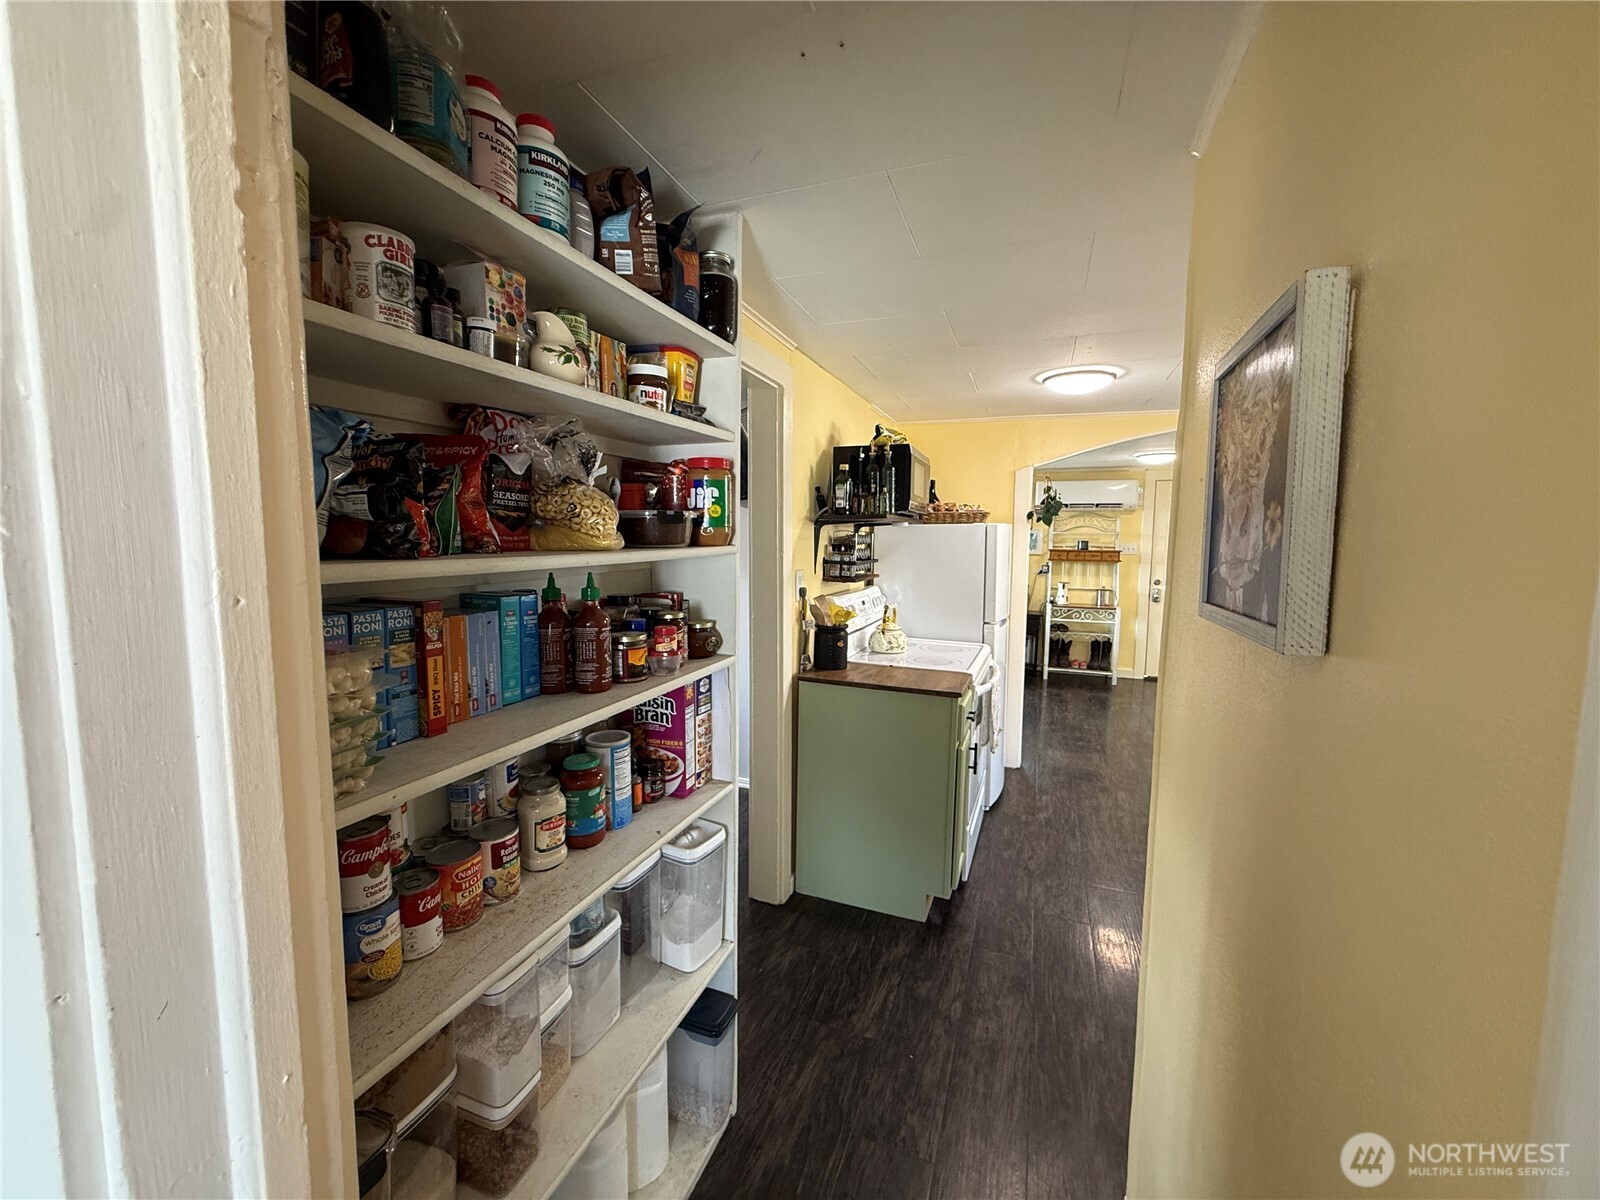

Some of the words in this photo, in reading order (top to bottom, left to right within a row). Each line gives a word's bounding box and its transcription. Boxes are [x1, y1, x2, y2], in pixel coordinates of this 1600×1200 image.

[478, 131, 512, 152] CALCIUM
[519, 167, 560, 184] MAGNESIUM
[543, 180, 555, 190] 250
[383, 248, 412, 269] GIRL
[640, 389, 665, 402] nutel
[424, 446, 478, 455] OT&SPICY
[492, 490, 530, 502] SEASONE
[687, 486, 720, 509] Jif
[353, 613, 382, 624] PASTA
[387, 608, 413, 619] PASTA
[322, 616, 345, 627] ASTA
[353, 621, 382, 634] RONI
[388, 616, 414, 629] RONI
[323, 626, 346, 637] ONI
[432, 689, 442, 717] SPICY
[636, 696, 676, 715] isin
[633, 708, 671, 727] Bran
[661, 738, 679, 747] FIBER
[363, 879, 383, 893] Cream
[365, 883, 388, 899] Chicken
[360, 918, 382, 931] Great
[364, 932, 390, 947] Whole
